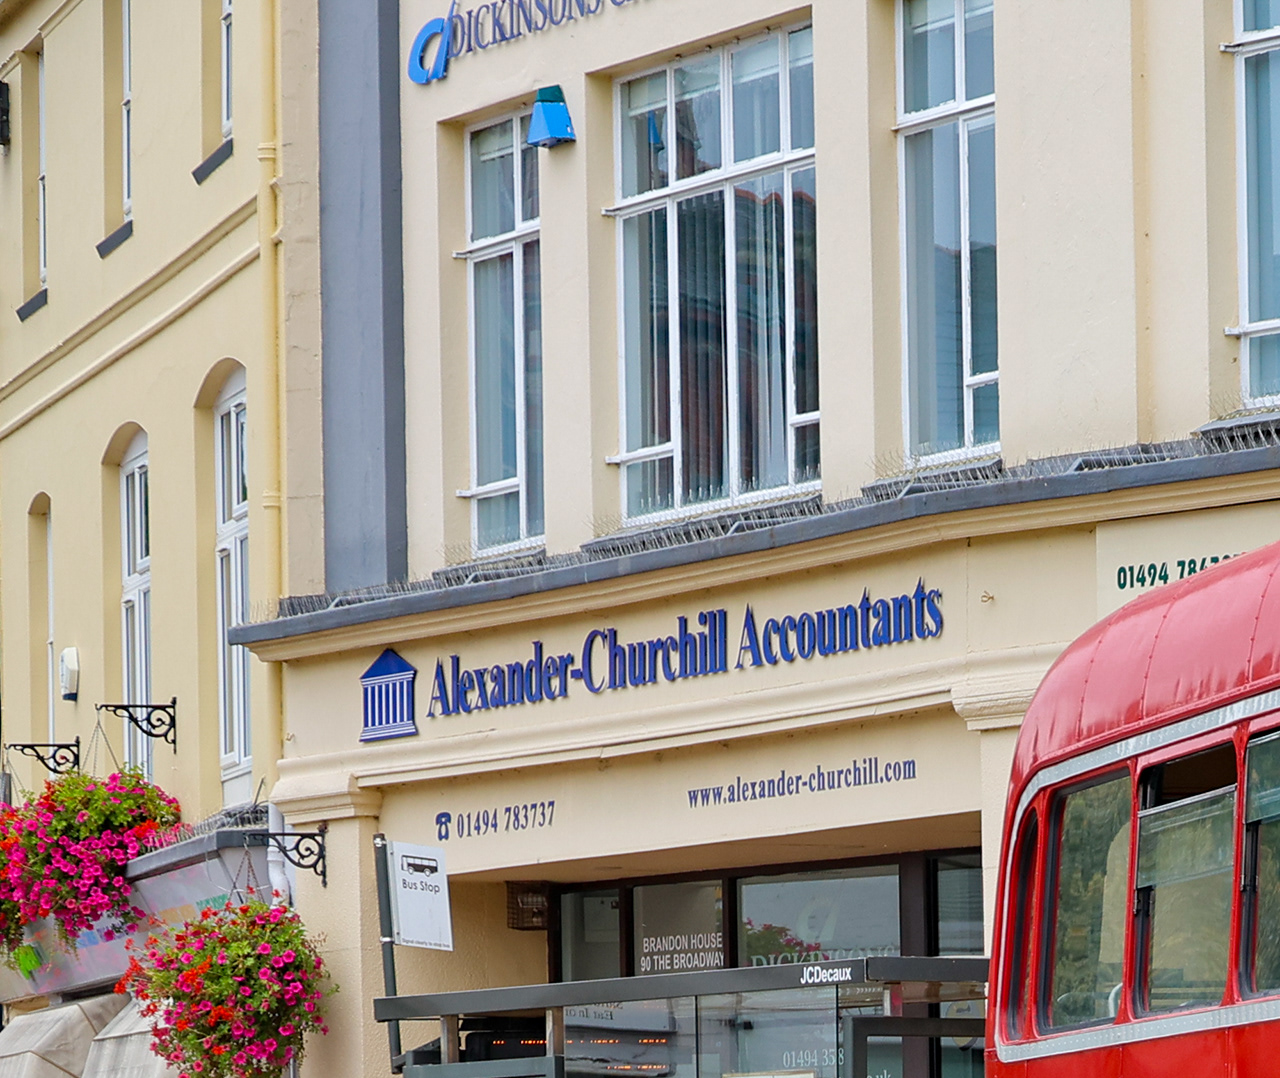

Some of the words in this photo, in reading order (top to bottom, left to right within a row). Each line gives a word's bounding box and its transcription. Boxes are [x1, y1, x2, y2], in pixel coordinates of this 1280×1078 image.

[1117, 562, 1169, 590] 01494
[426, 608, 728, 718] Alexander-Churchill
[734, 576, 944, 670] Accountants
[687, 757, 917, 809] www.alexander-churchill.com
[456, 808, 498, 839] 01494
[504, 800, 555, 833] 783737
[402, 879, 418, 890] Bus
[420, 881, 440, 895] Stop
[643, 934, 688, 952] BRANDON
[691, 932, 723, 951] HOUSE
[640, 956, 651, 972] 90
[653, 955, 671, 970] THE
[673, 951, 724, 969] BROADWAY
[800, 966, 851, 984] JCDecaux
[782, 1050, 818, 1067] 01494
